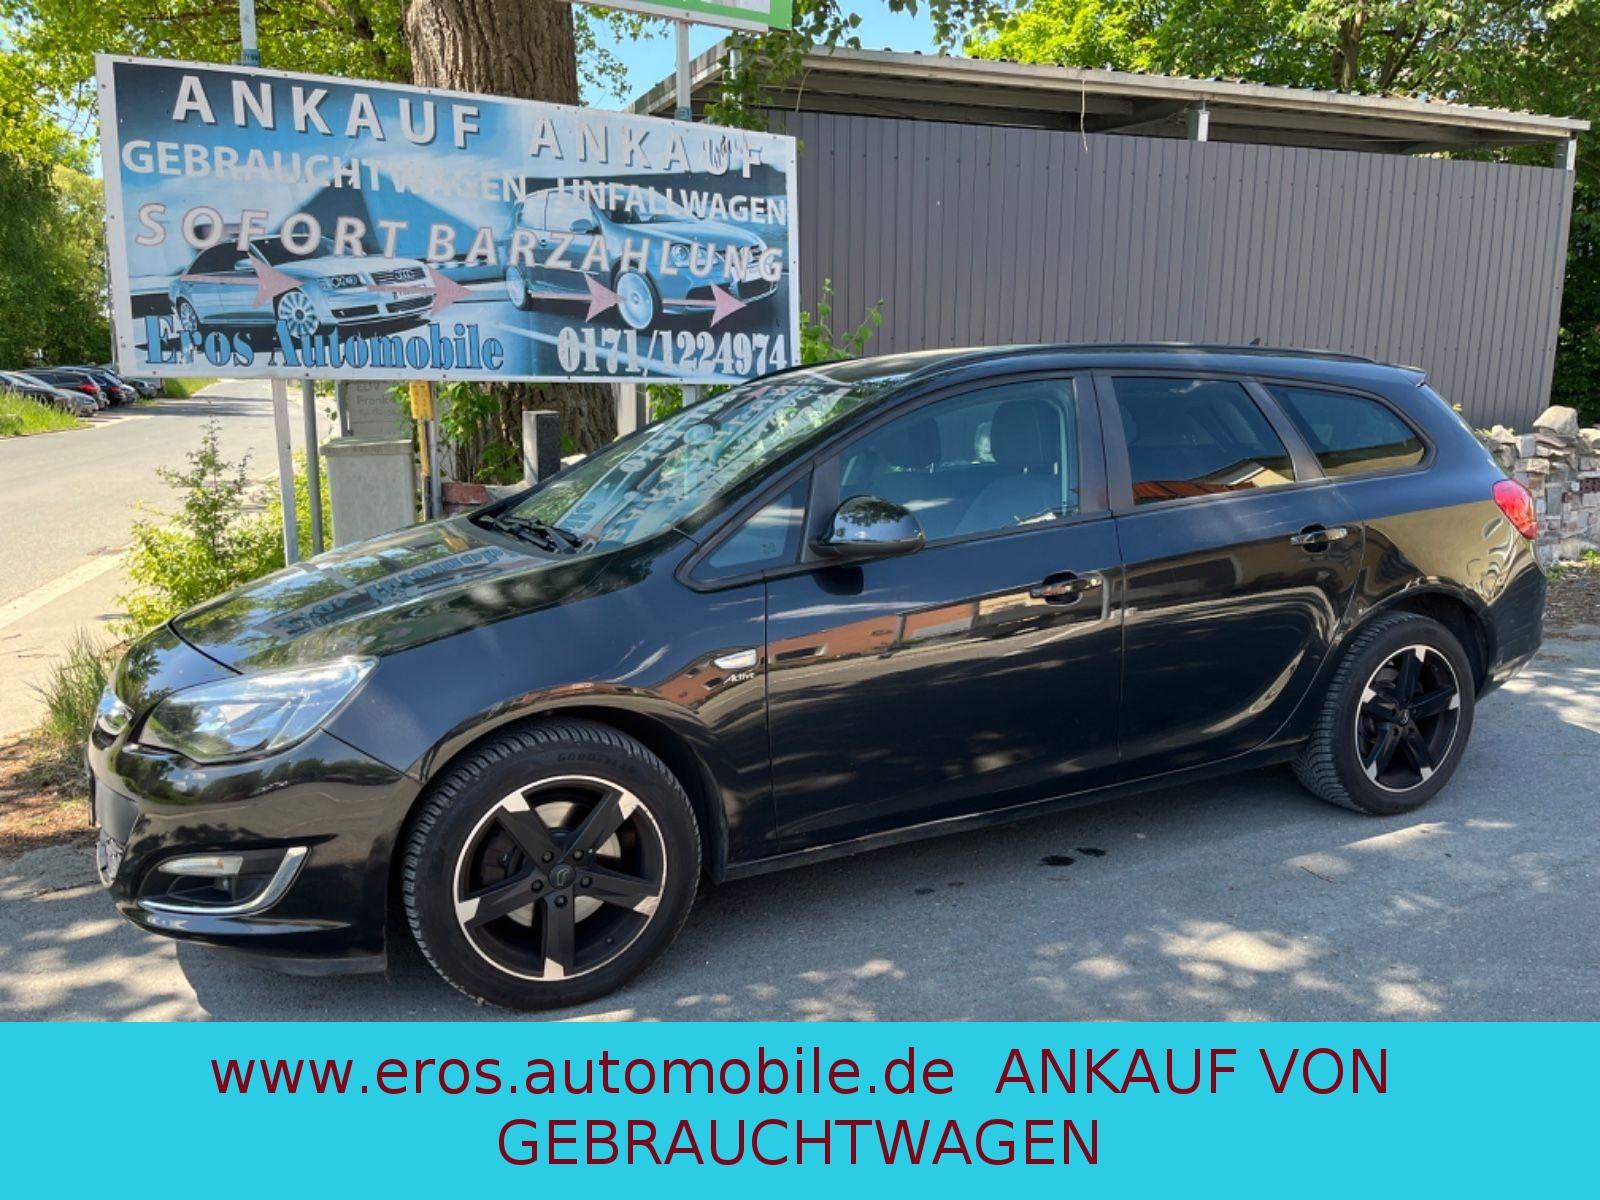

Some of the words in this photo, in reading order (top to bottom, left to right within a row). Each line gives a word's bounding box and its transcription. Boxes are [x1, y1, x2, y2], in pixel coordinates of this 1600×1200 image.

[172, 75, 481, 149] ANKAUF
[530, 117, 764, 179] ANKAUF
[122, 140, 526, 202] GEBRAUCHTWAGEN
[556, 177, 788, 225] UNFALLWAGEN
[135, 203, 408, 259] SOFORT
[427, 223, 784, 282] BARZAHLUNG
[145, 315, 255, 366] Eros
[268, 319, 505, 371] Automobile
[556, 326, 788, 377] 0171/1224974
